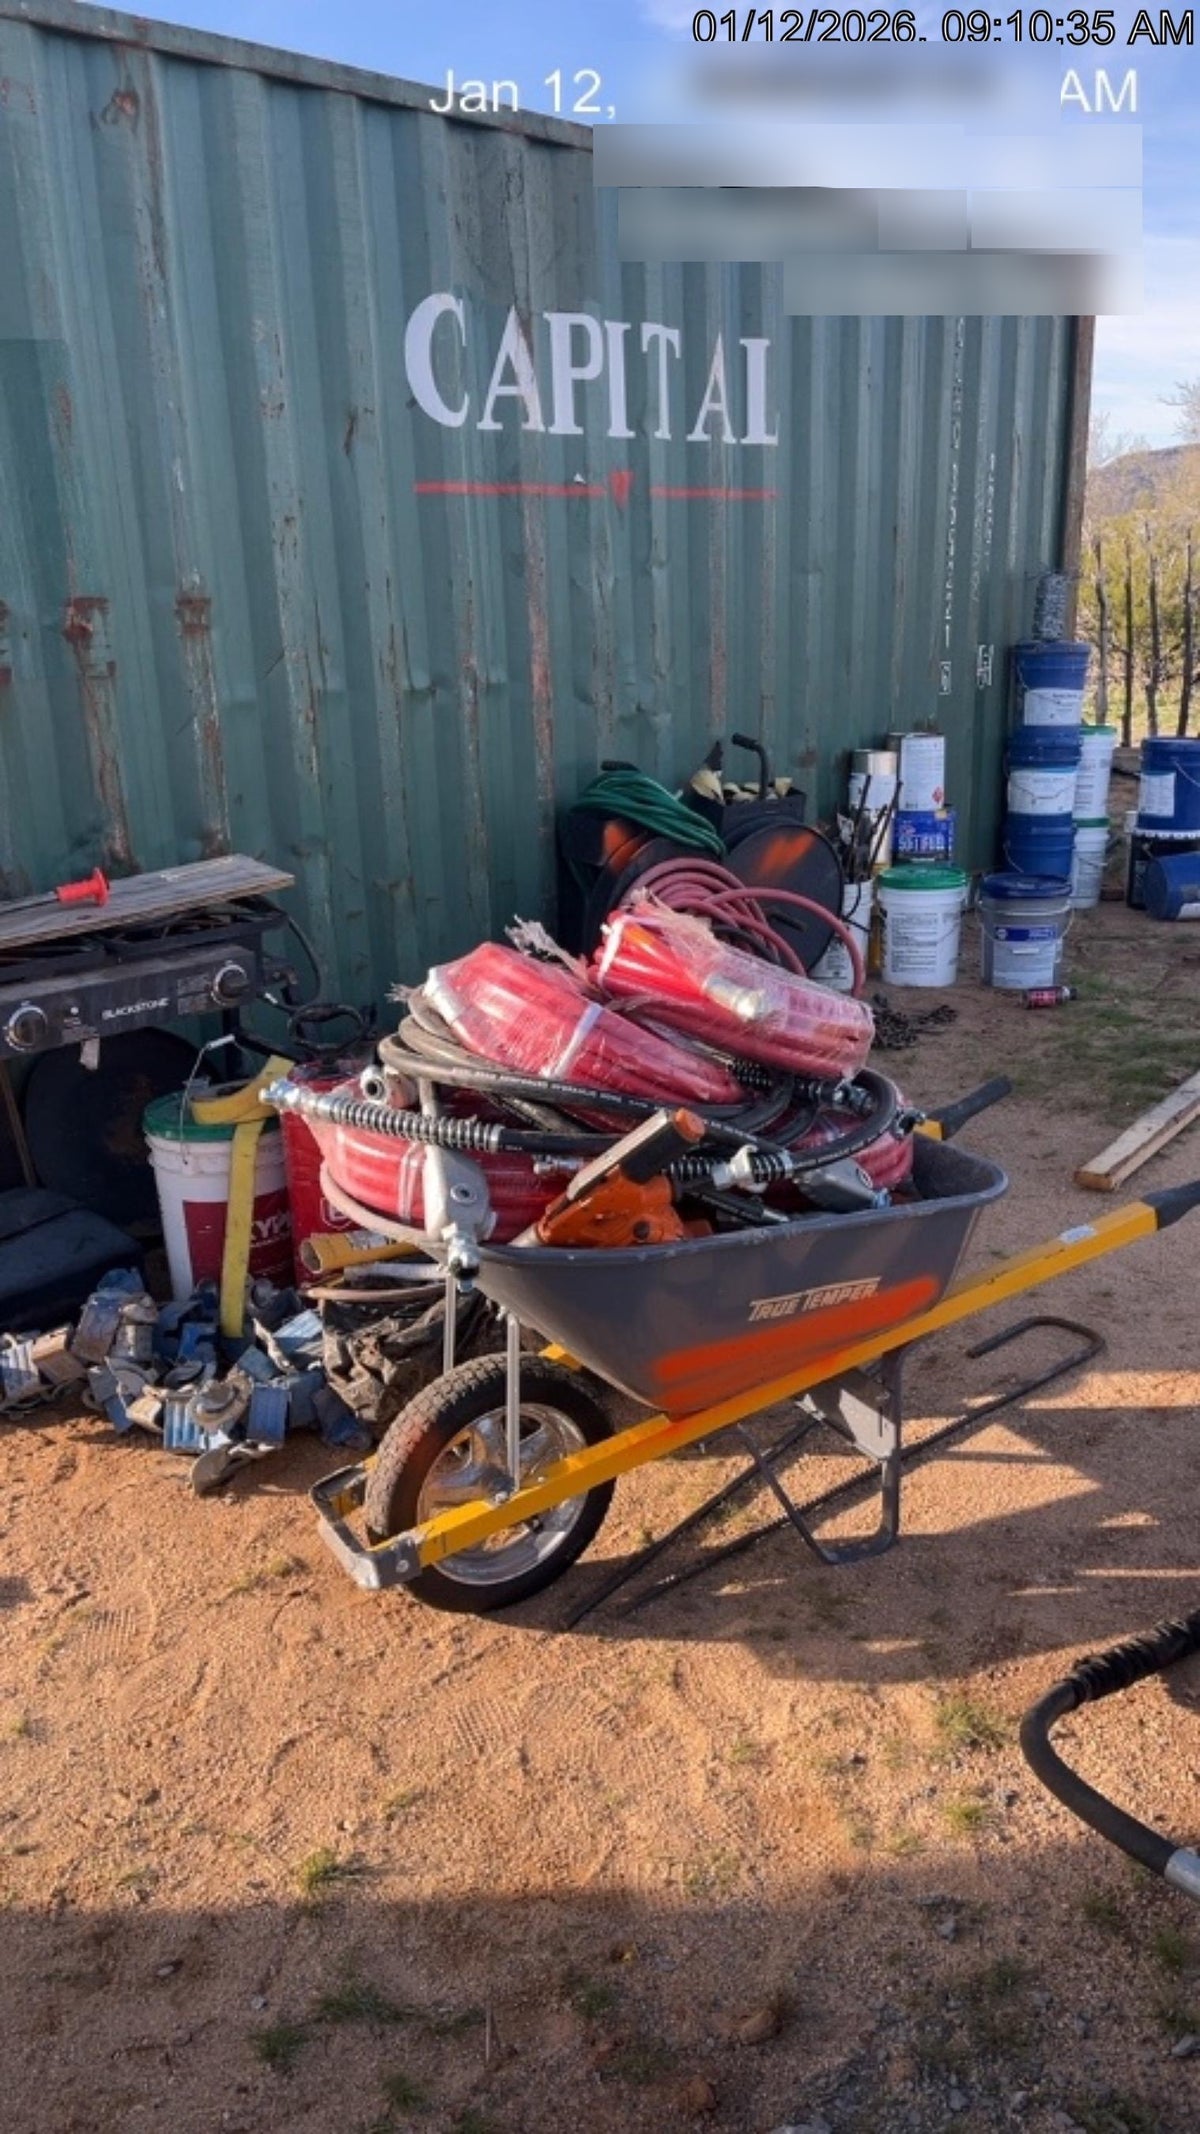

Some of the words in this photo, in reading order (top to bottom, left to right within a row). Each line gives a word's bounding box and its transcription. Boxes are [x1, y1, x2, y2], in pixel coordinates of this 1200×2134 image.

[404, 291, 780, 447] CAPITAL
[101, 998, 170, 1020] BLACKSTONE
[748, 1291, 802, 1322] TRUE
[801, 1275, 882, 1313] TEMPER
